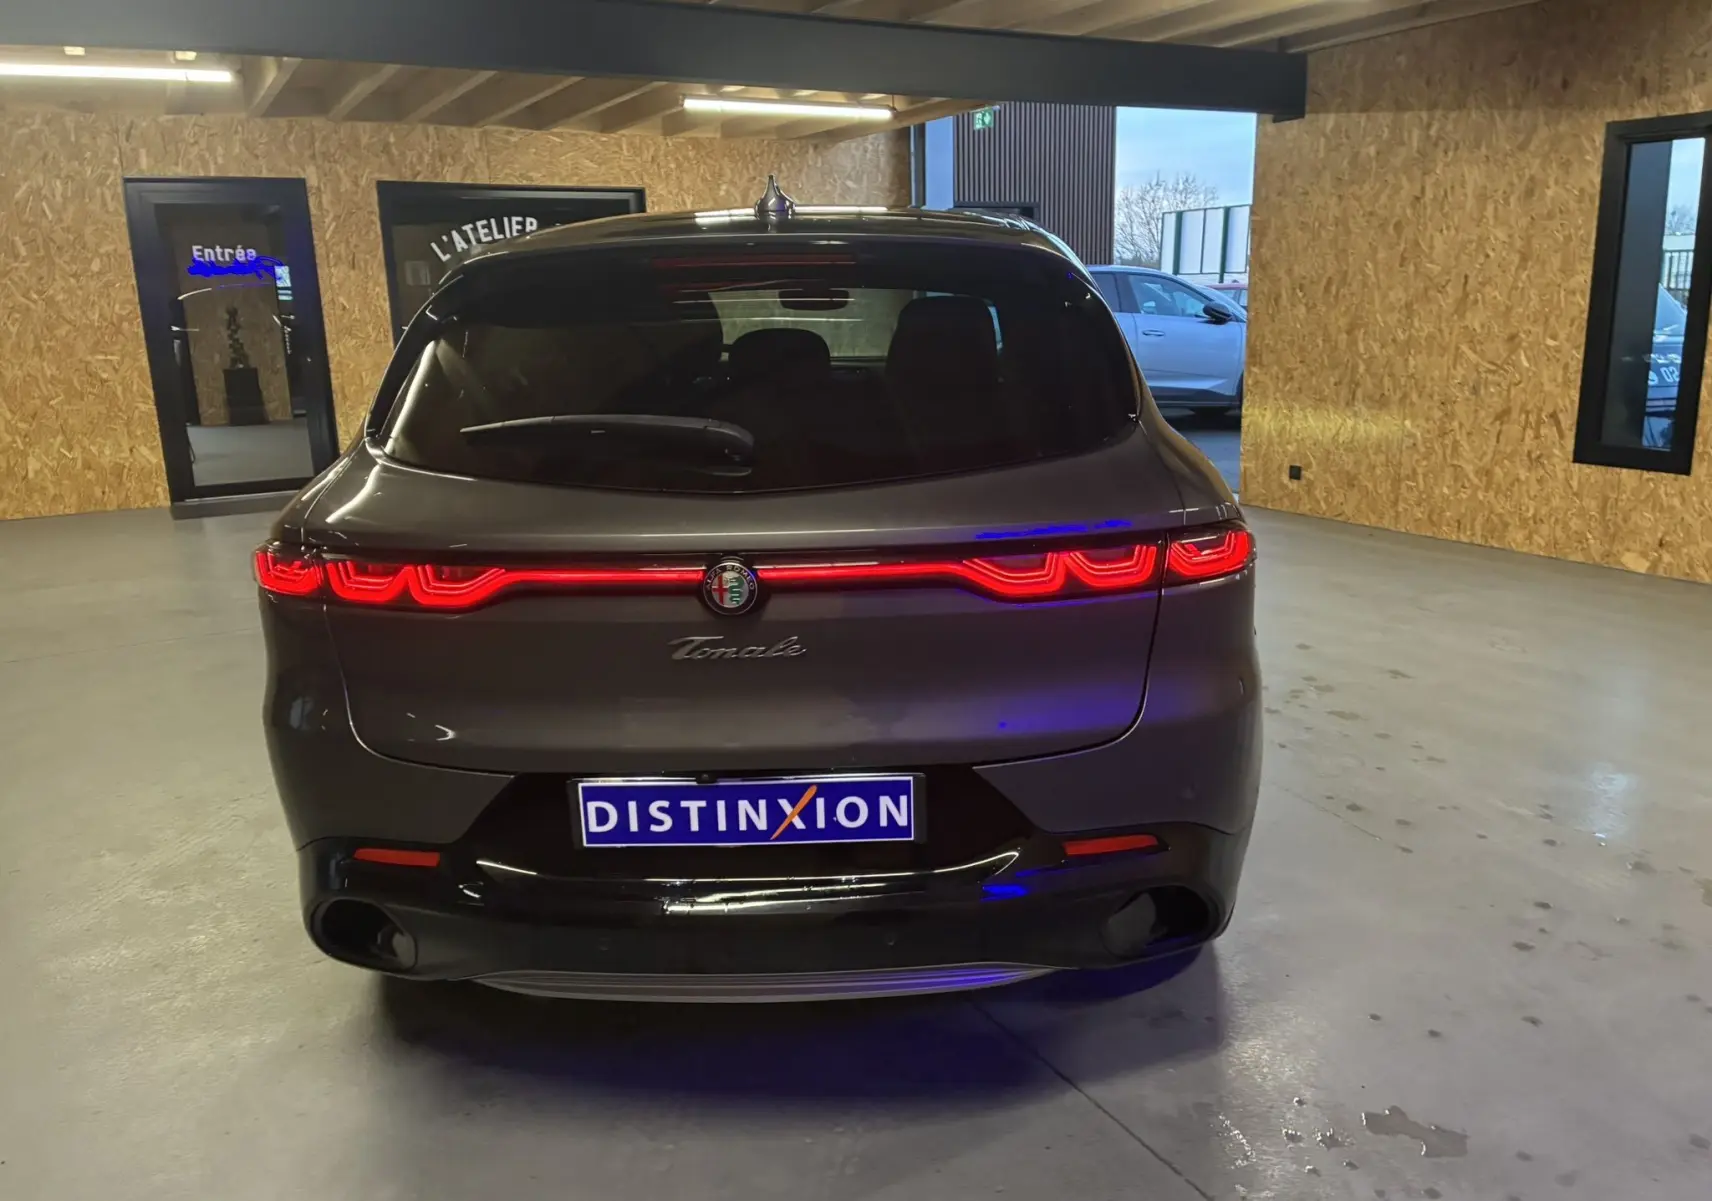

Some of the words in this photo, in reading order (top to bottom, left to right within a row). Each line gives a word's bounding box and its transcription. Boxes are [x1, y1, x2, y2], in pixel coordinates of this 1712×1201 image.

[191, 244, 257, 263] Entrée
[726, 565, 755, 590] ROMEO
[667, 635, 807, 661] Tonale
[585, 784, 909, 840] DISTINXION
